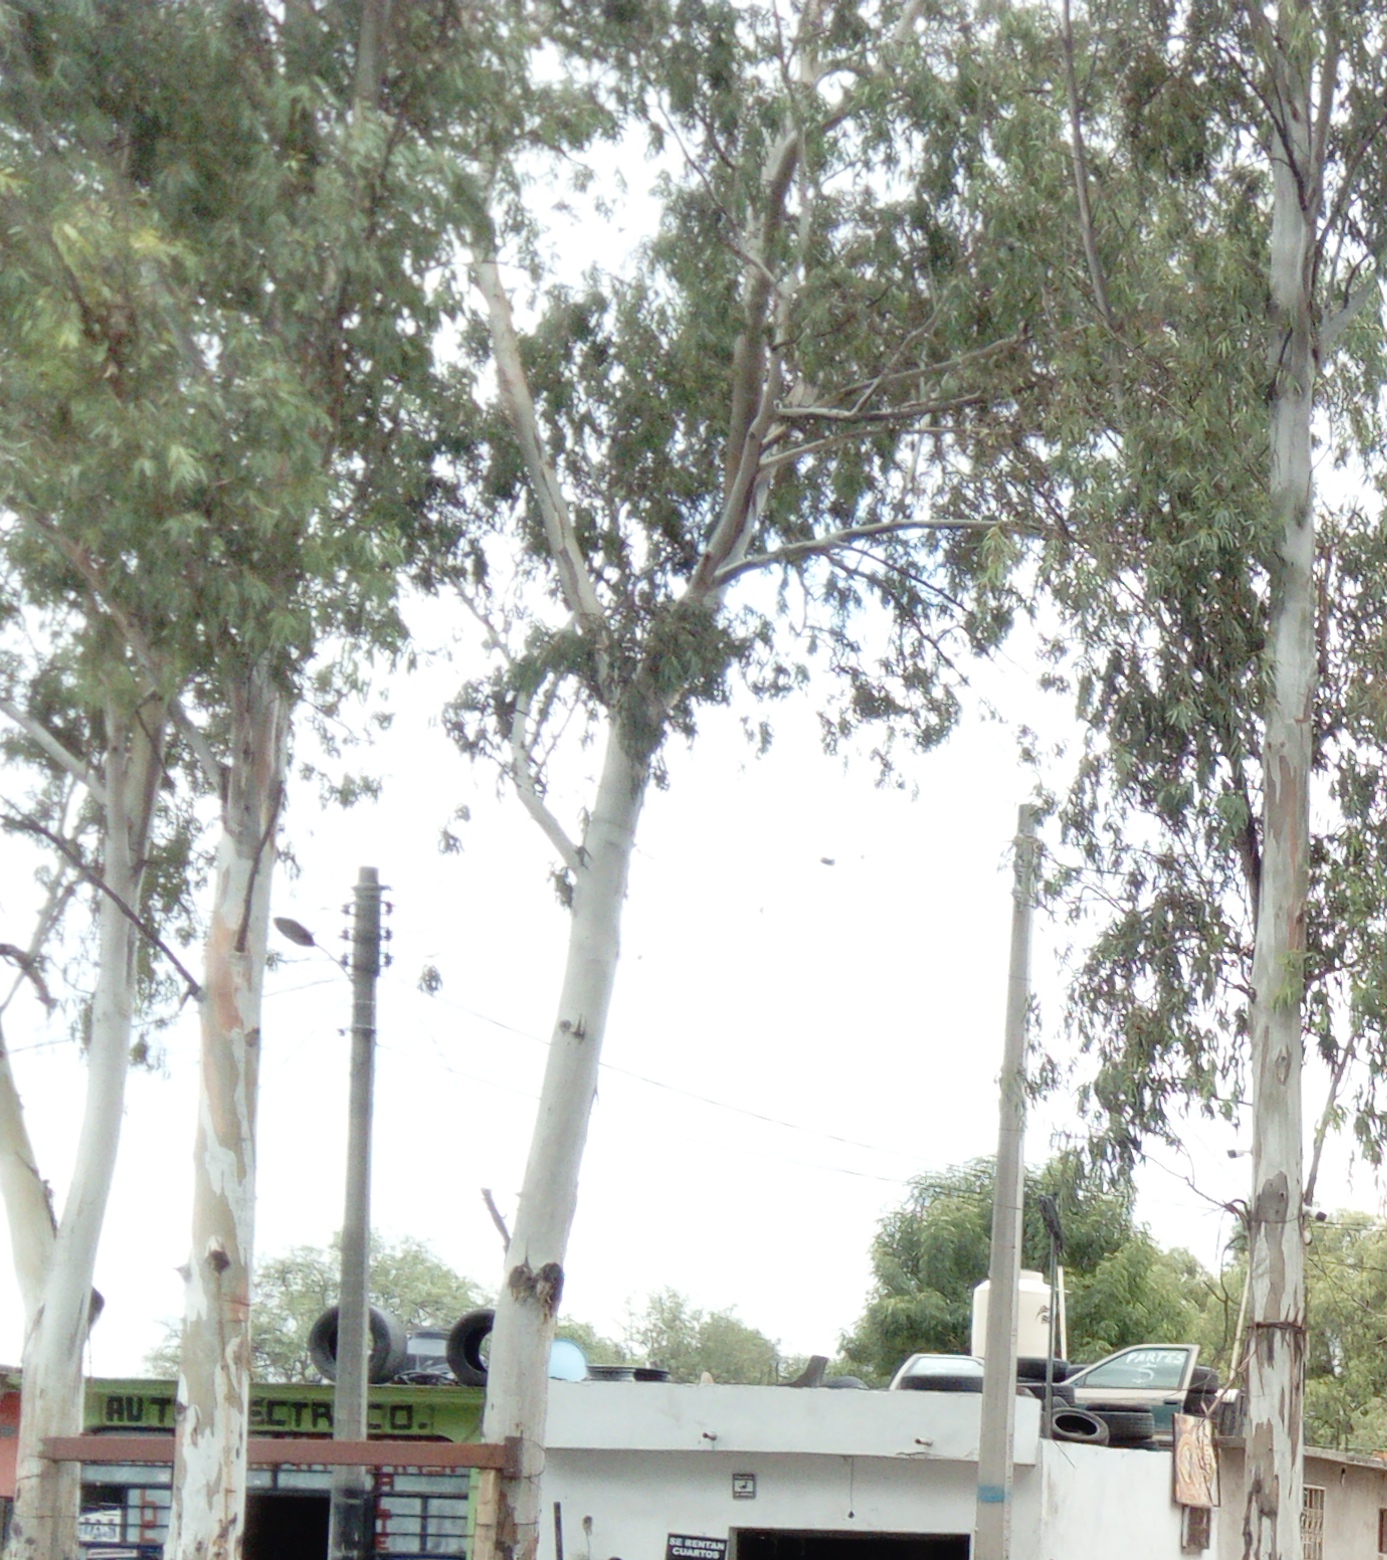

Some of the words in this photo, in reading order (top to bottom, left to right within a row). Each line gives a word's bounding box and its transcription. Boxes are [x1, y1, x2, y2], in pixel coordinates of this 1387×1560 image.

[669, 1537, 683, 1546] SE
[685, 1539, 725, 1550] RENTAN
[672, 1547, 720, 1559] CUARTOS
